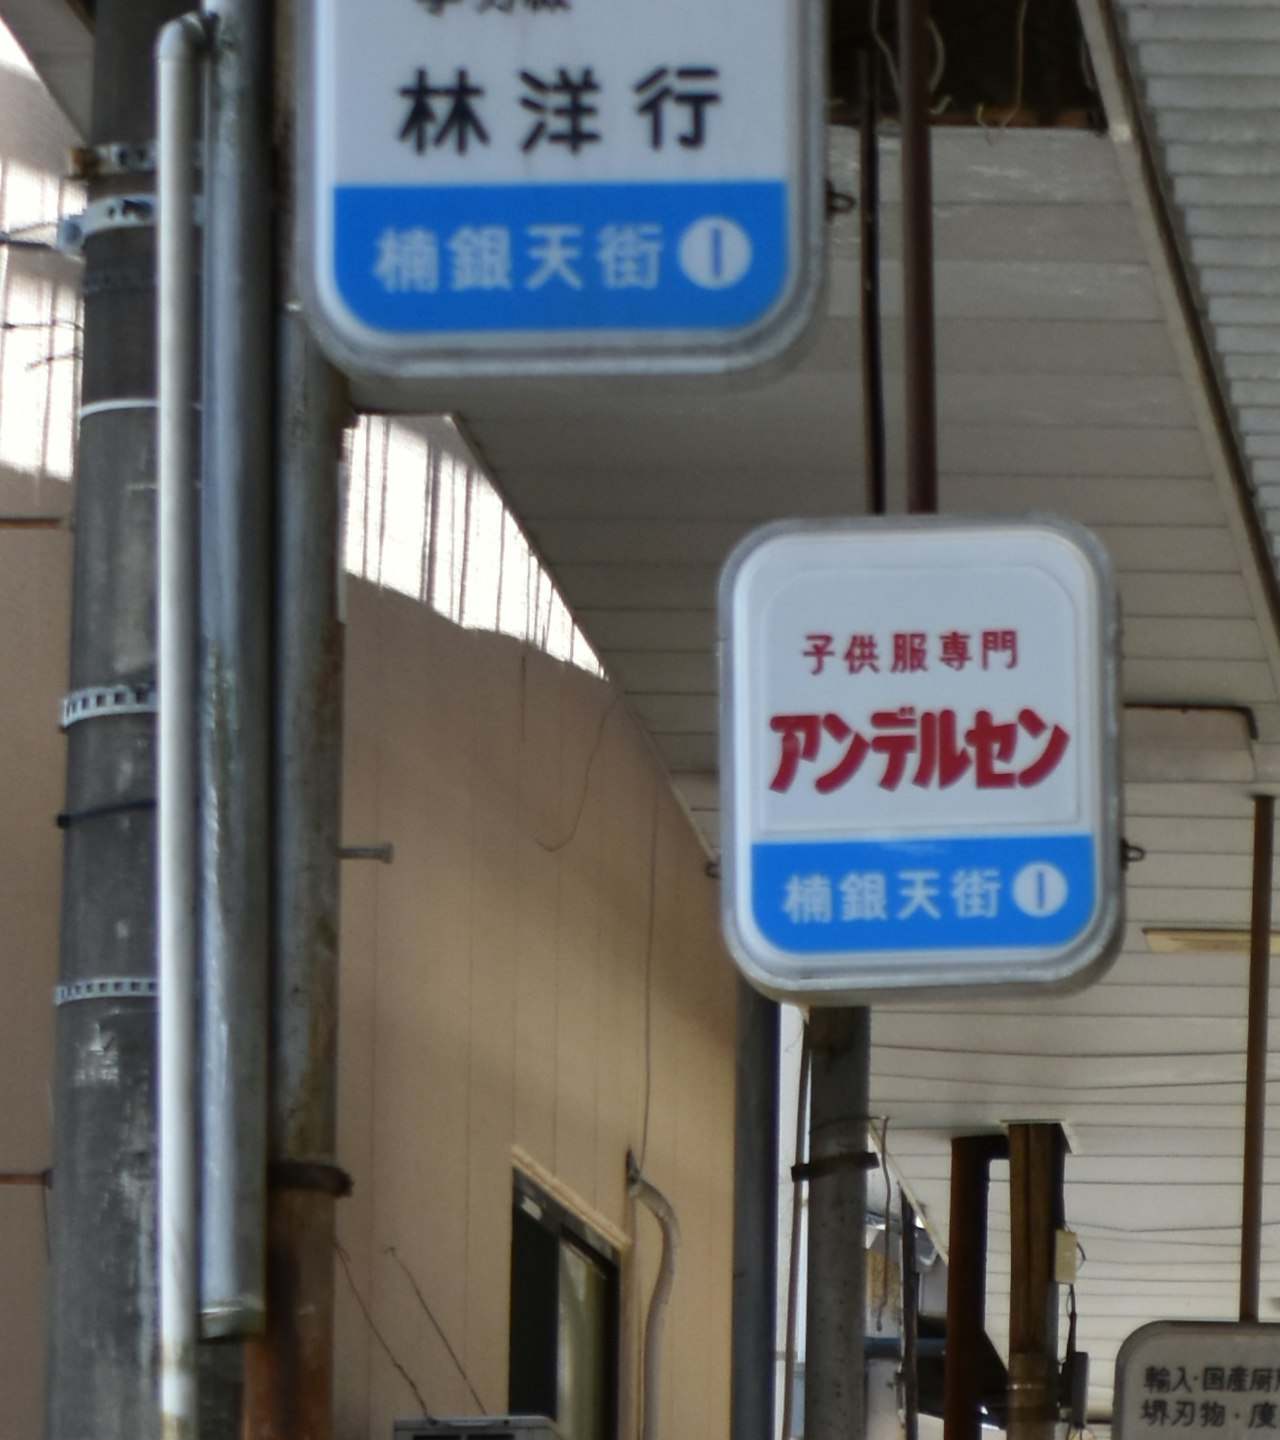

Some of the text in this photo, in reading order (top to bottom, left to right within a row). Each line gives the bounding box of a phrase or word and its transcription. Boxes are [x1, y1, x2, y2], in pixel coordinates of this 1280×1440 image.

[398, 67, 721, 156] 林洋行
[803, 629, 1018, 676] 子供服専門
[769, 706, 1070, 794] アンデルセン
